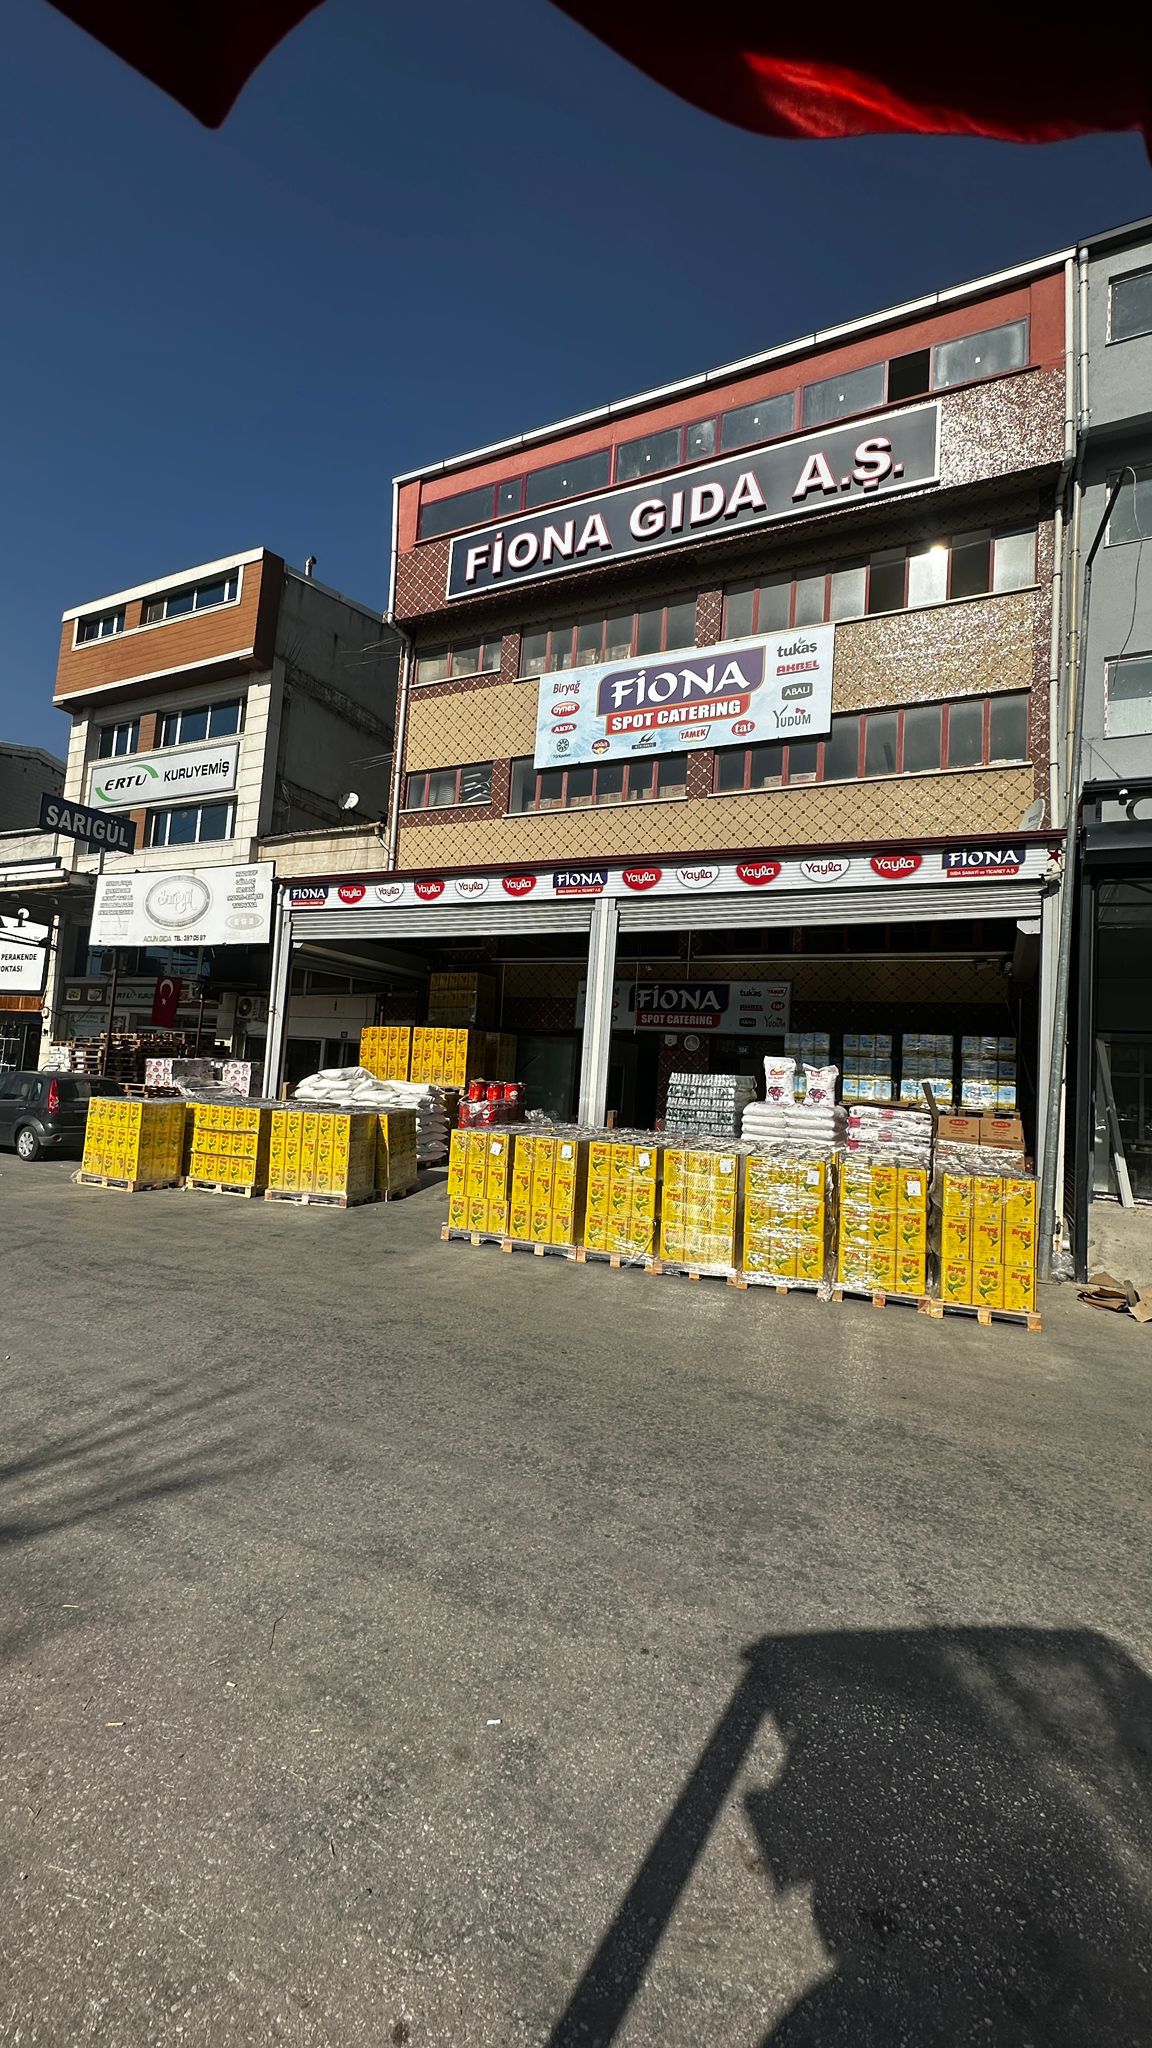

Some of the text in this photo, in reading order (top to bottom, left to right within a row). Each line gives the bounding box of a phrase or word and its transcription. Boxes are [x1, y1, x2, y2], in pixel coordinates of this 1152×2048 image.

[629, 470, 767, 541] GIDA
[792, 437, 905, 502] A.Ş.
[612, 712, 655, 731] SPOT
[681, 728, 706, 739] TAMEK
[735, 723, 752, 733] tat
[105, 759, 230, 791] ERTU KURUYEMİŞ
[46, 804, 129, 848] SARIGÜL
[805, 861, 843, 874] Yayla
[875, 857, 915, 871] Yayla
[681, 869, 713, 881] Yayla
[740, 866, 775, 878] Yayla
[625, 872, 657, 884] Yayla
[417, 883, 441, 894] Yayla
[458, 881, 484, 892] Yayla
[505, 879, 532, 890] Yayla
[340, 888, 362, 899] Yayla
[378, 886, 400, 896] Yayla
[1, 953, 38, 961] PERAKENDE
[0, 965, 23, 973] OKTASI
[641, 1014, 665, 1024] SPOT
